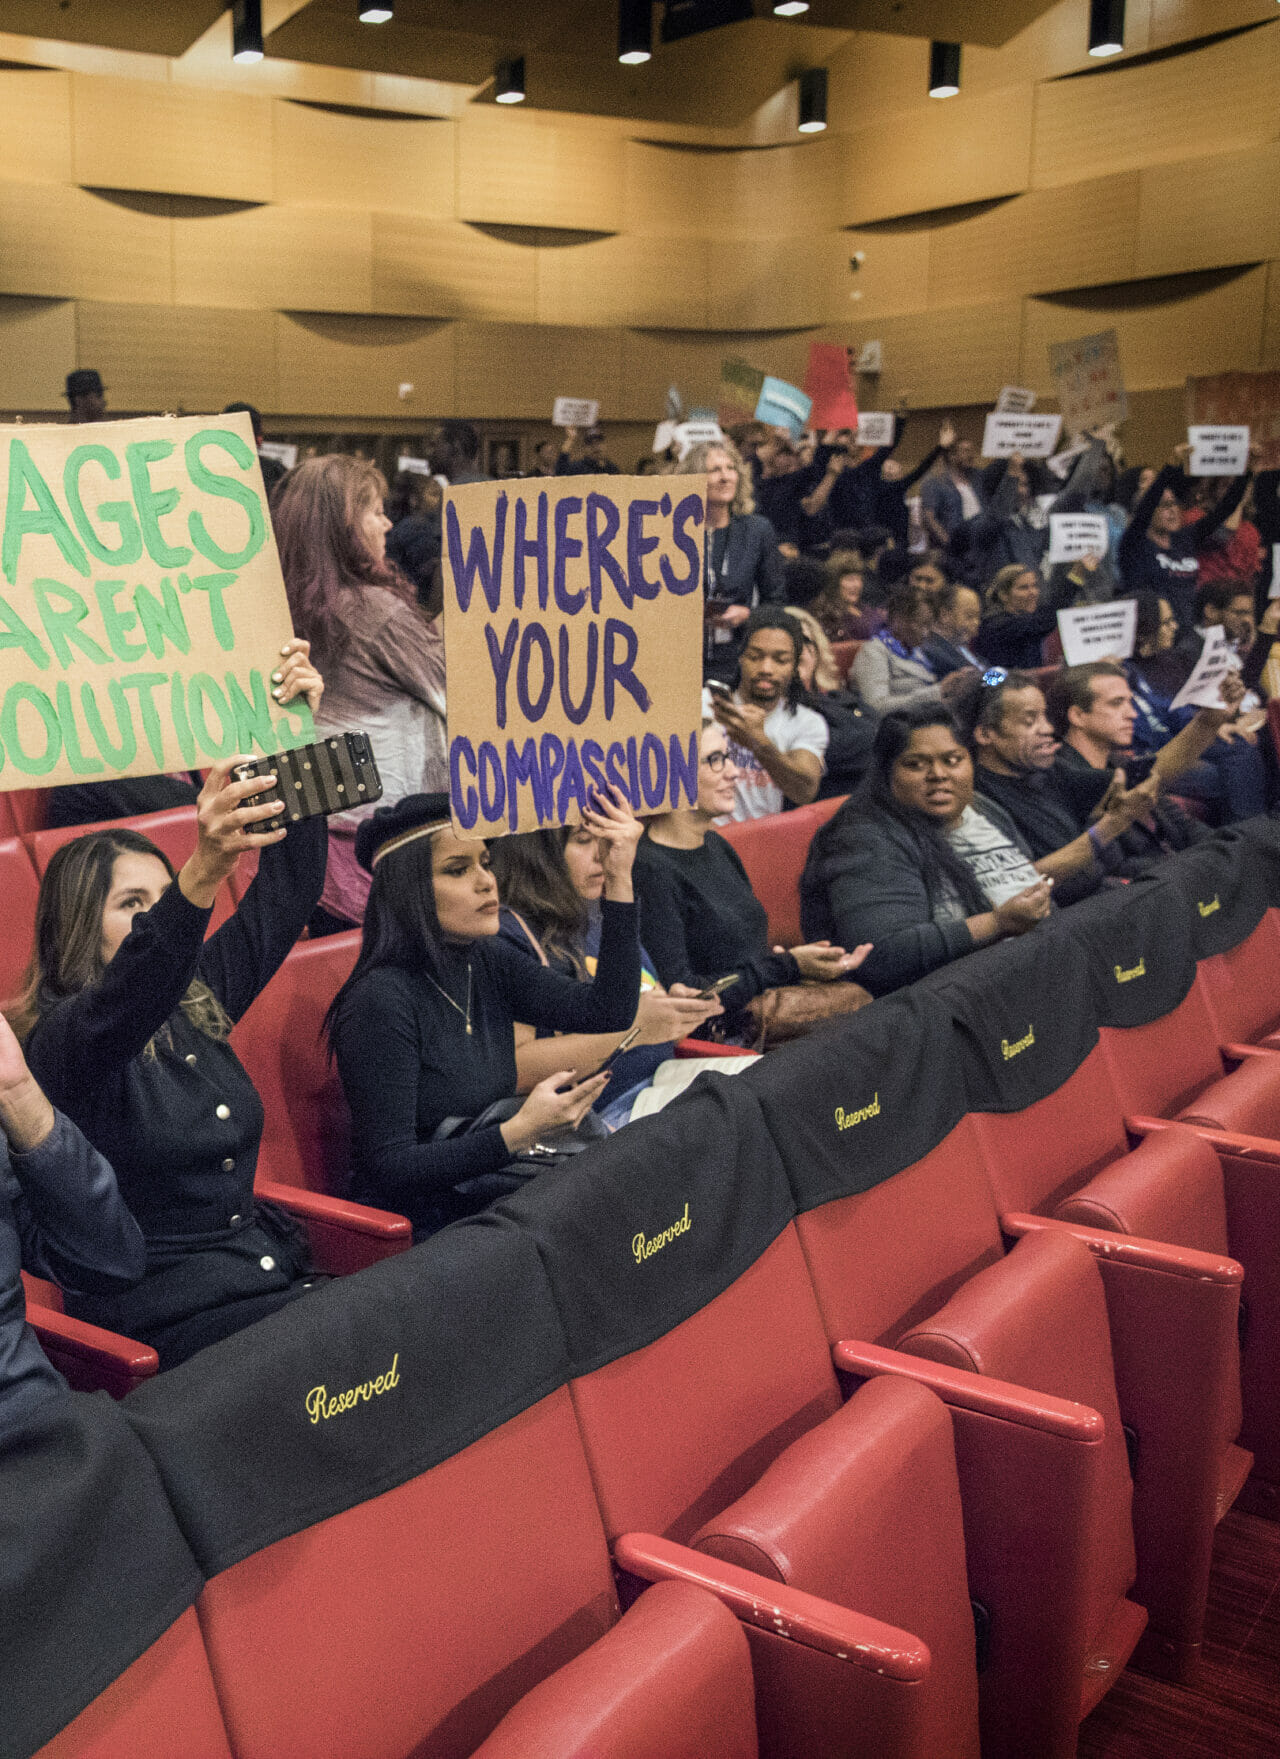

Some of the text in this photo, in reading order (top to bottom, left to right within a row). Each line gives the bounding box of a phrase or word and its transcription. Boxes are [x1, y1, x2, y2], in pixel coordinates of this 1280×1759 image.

[445, 489, 705, 616] WHERE'S
[483, 617, 654, 730] YOUR
[449, 729, 700, 833] COMPASSION
[834, 1090, 881, 1132] Reserved
[631, 1202, 692, 1265] Reserved
[305, 1352, 401, 1425] Reserved
